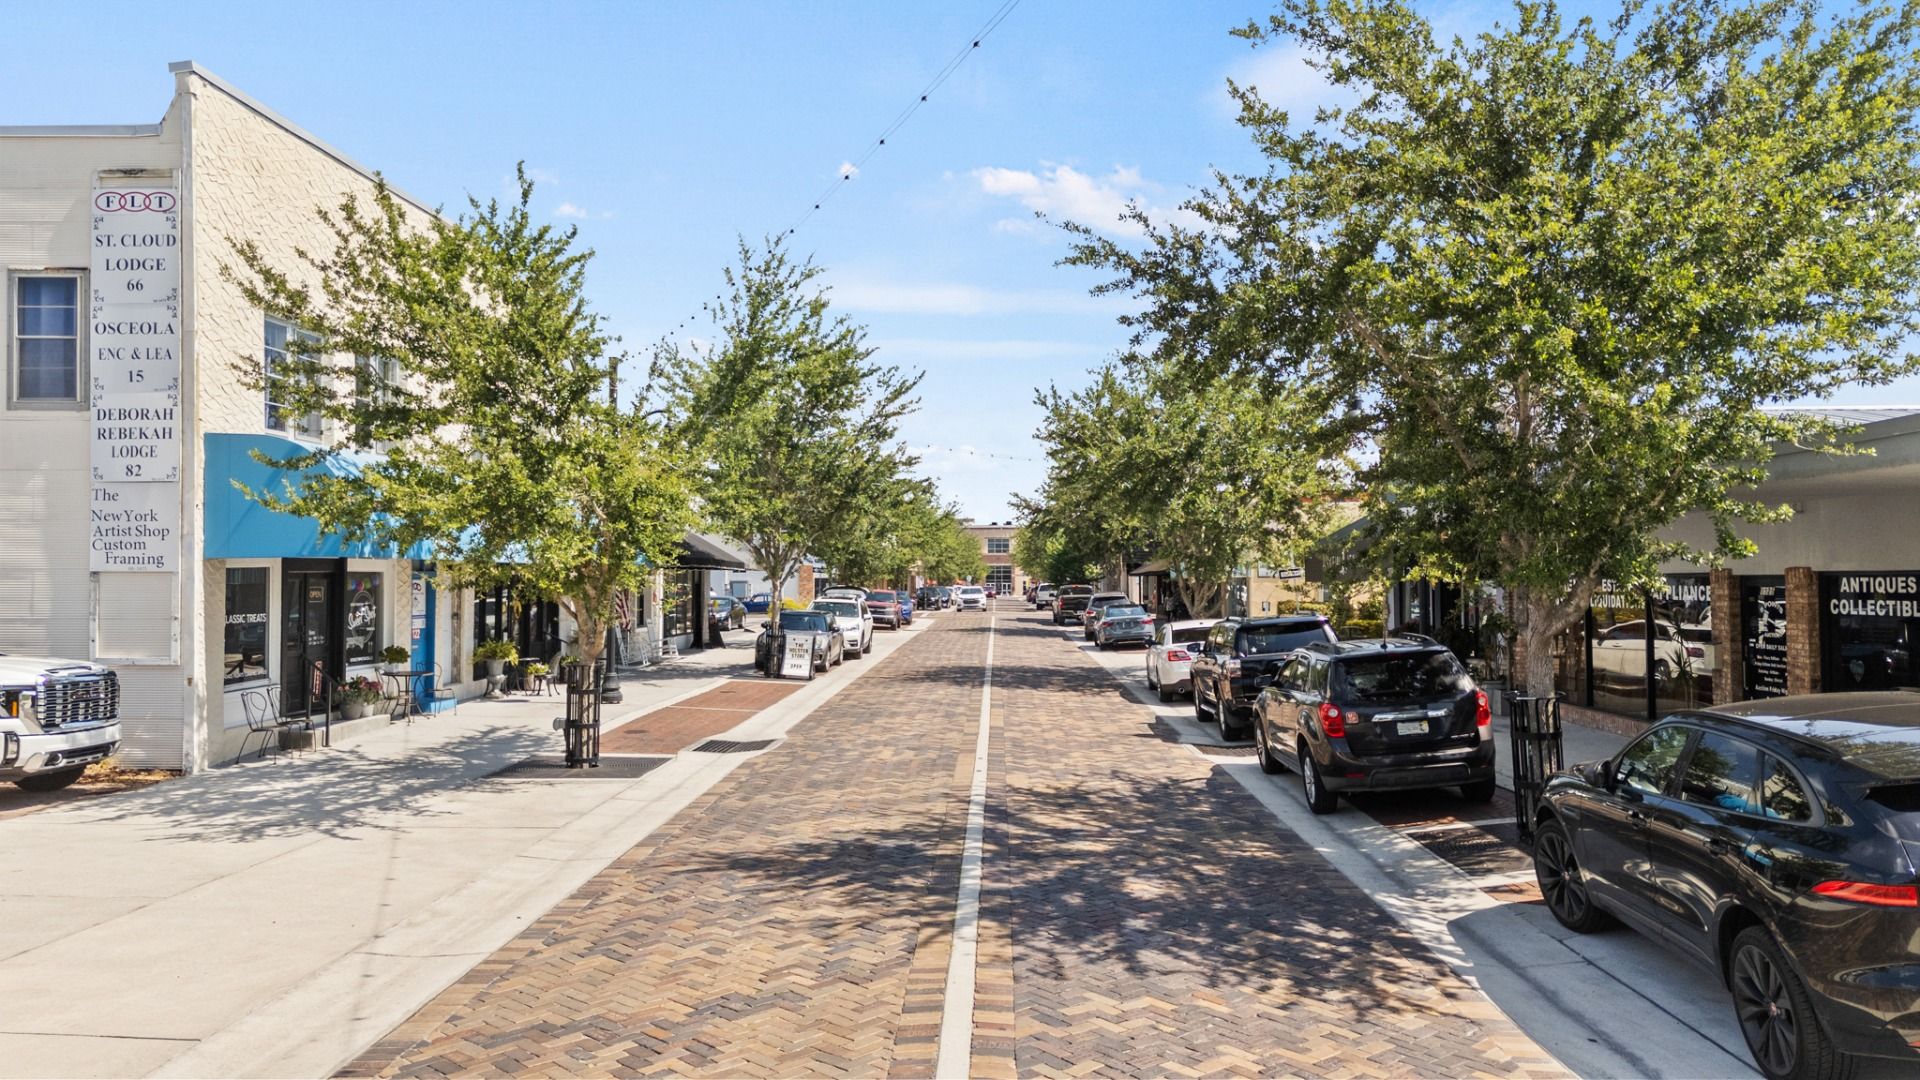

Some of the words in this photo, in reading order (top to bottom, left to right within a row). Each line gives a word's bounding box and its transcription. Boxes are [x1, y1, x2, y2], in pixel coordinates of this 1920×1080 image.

[105, 195, 116, 208] F
[130, 195, 142, 208] L
[154, 195, 167, 208] T
[95, 234, 117, 247] ST.
[120, 233, 177, 247] CLOUD
[105, 258, 166, 271] LODGE
[127, 279, 144, 292] 66
[94, 321, 175, 335] OSCEOLA
[98, 347, 126, 360] ENC
[131, 347, 141, 360] &
[146, 347, 172, 360] LEA
[128, 370, 144, 383] 15
[96, 408, 174, 421] DEBORAH
[97, 427, 173, 440] REBEKAH
[111, 445, 158, 458] LODGE
[125, 464, 142, 477] 82
[91, 488, 119, 502] The
[91, 509, 122, 522] New
[124, 508, 159, 522] York
[93, 525, 132, 537] Artist
[135, 524, 170, 541] Shop
[92, 538, 147, 551] Custom
[105, 551, 165, 569] Framing
[1840, 577, 1917, 594] ANTIQUES
[1590, 594, 1645, 610] LIQUIDAT
[1830, 599, 1920, 617] COLLECTIBL
[225, 614, 246, 624] LASSIC
[246, 613, 267, 623] TREATS
